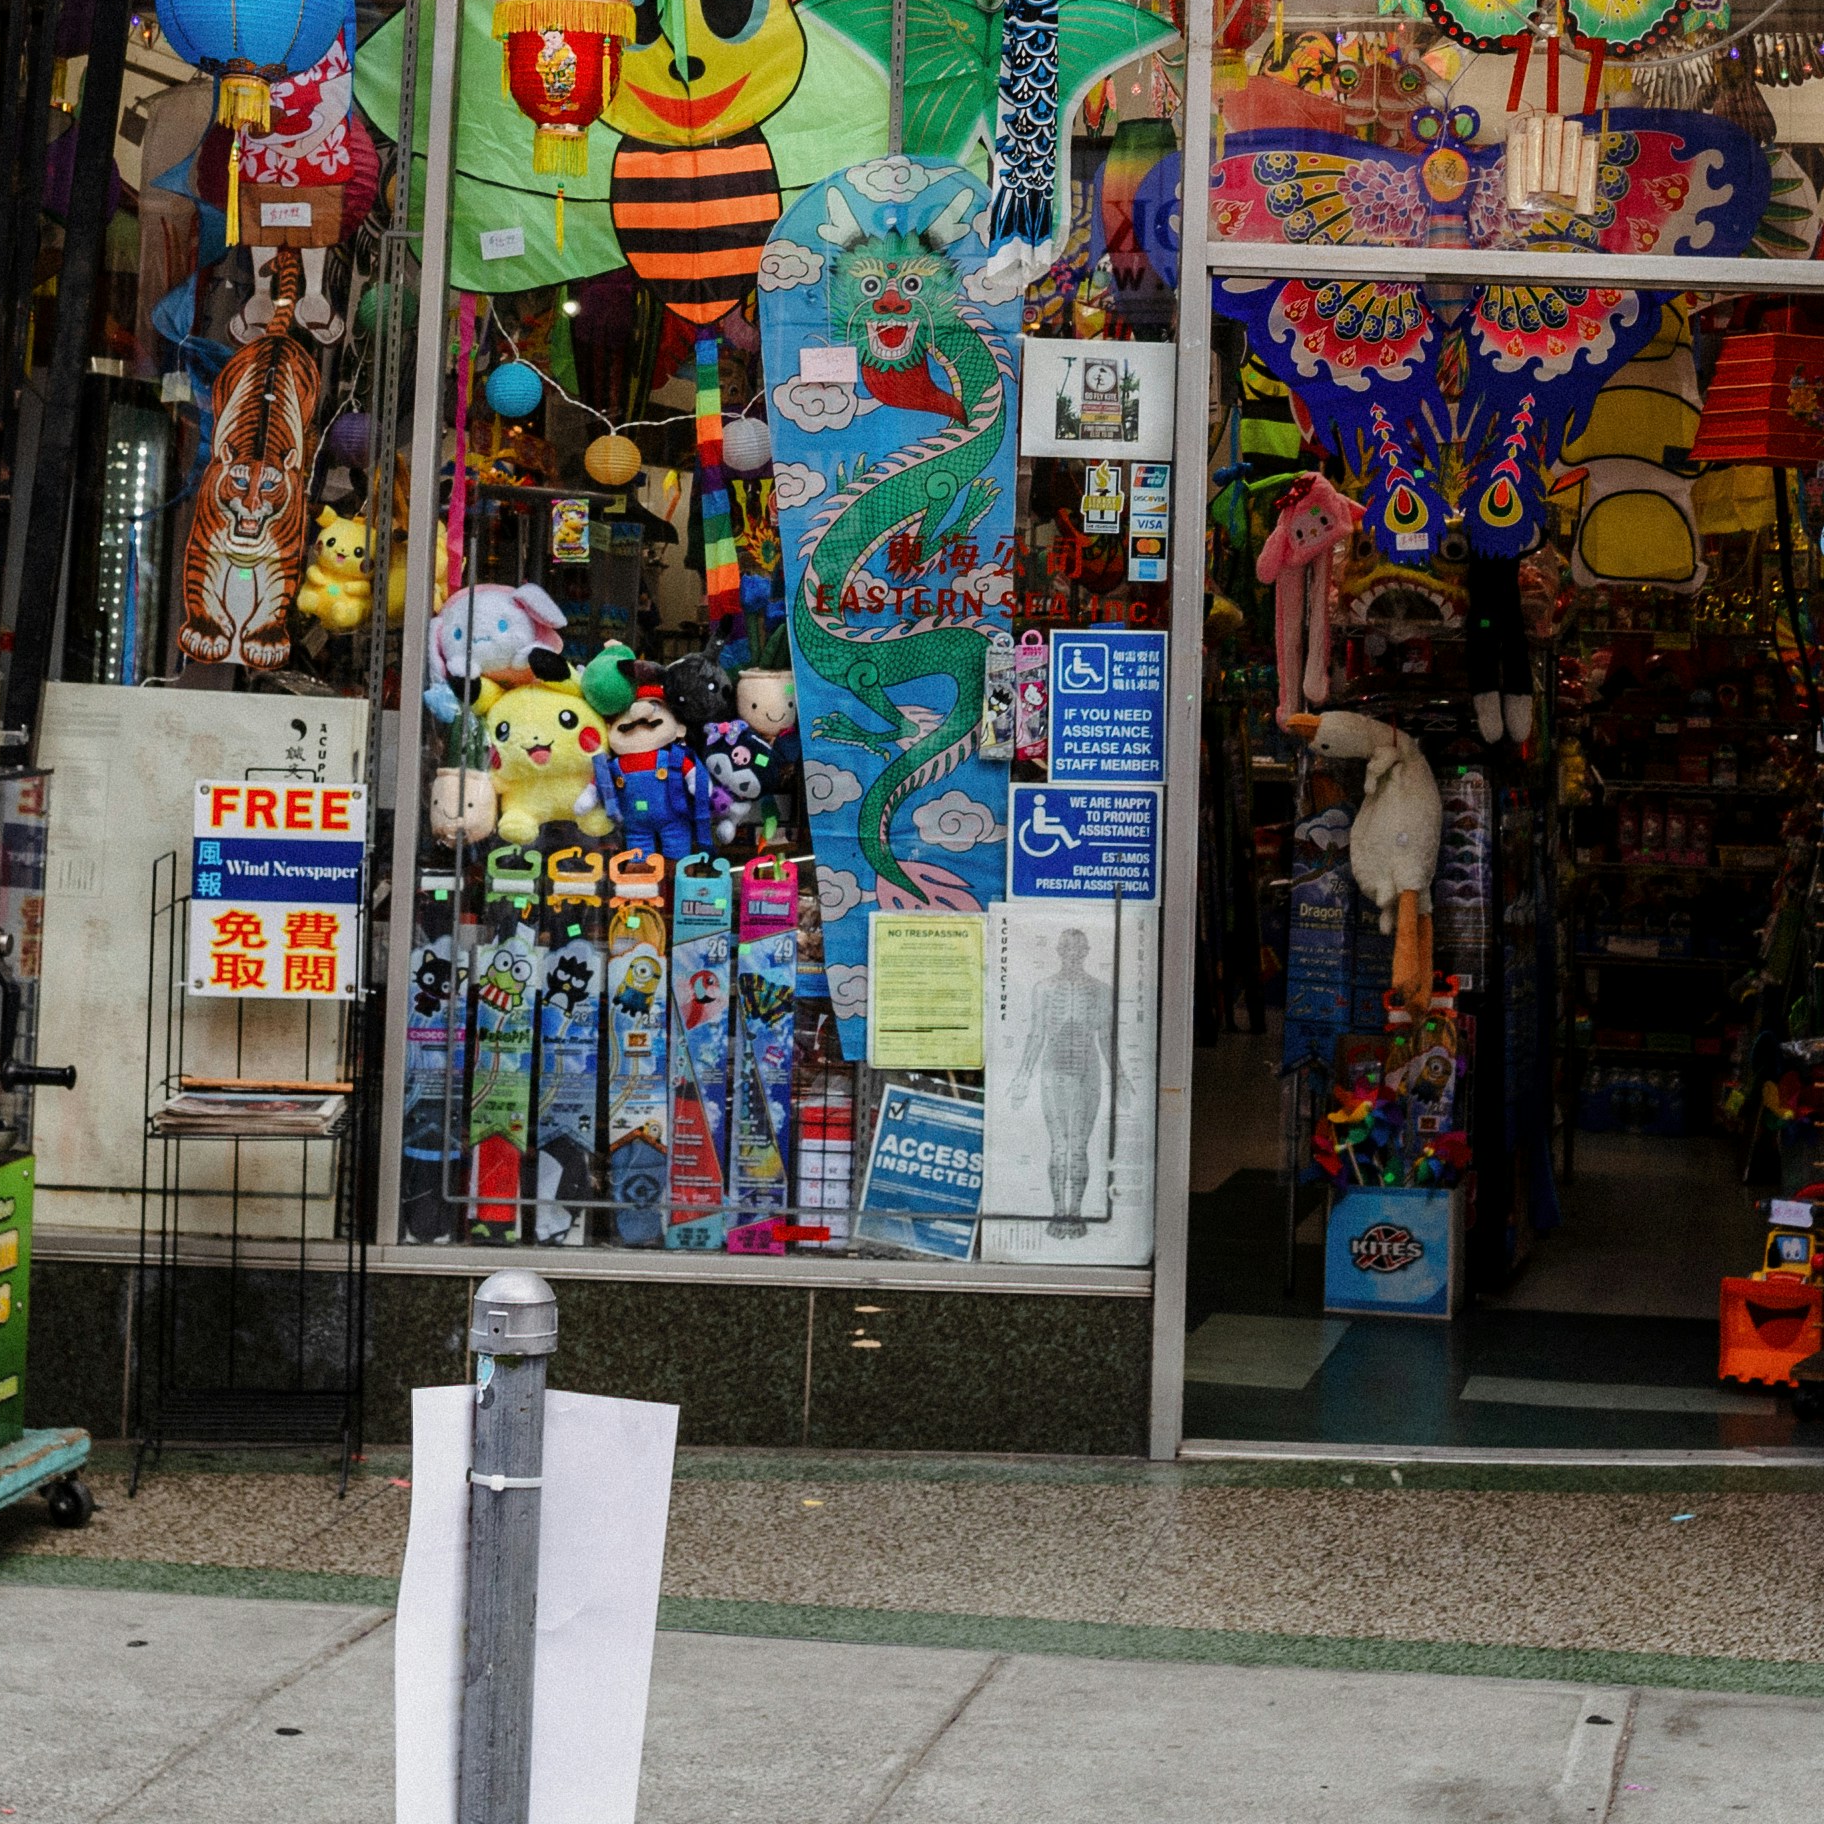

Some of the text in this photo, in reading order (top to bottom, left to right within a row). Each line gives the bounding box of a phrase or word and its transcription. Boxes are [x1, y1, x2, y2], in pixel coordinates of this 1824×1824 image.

[1503, 36, 1606, 114] 717
[1133, 495, 1166, 503] DISCOVER
[1137, 519, 1163, 529] VISA
[887, 534, 1085, 579] 東海公司
[814, 584, 984, 619] EASTERN
[1064, 708, 1153, 722] IF YOU NEED
[1062, 725, 1154, 739] ASSISTANCE,
[316, 722, 329, 783] ACUPU
[1064, 742, 1152, 755] PLEASE ASK
[1055, 758, 1160, 772] STAFF MEMBER
[209, 787, 352, 831] FREE
[1069, 796, 1152, 810] WE ARE HAPPY
[1086, 810, 1151, 824] TO PROVIDE
[1078, 824, 1150, 838] ASSISTANCE!
[196, 840, 224, 899] 風報
[225, 858, 359, 883] Wind Newspaper
[1072, 865, 1150, 878] ENCANTADOS A
[1035, 878, 1082, 890] PRESTAR
[1299, 902, 1344, 921] Dragon
[209, 908, 340, 951] 免費
[888, 929, 969, 940] NO TRESPASSING
[708, 938, 727, 958] 26
[774, 937, 794, 958] 29
[999, 917, 1009, 1022] ACUPUNCTURE
[879, 1133, 984, 1173] ACCESS
[875, 1154, 982, 1189] INSPECTED
[1351, 1238, 1423, 1261] KITES
